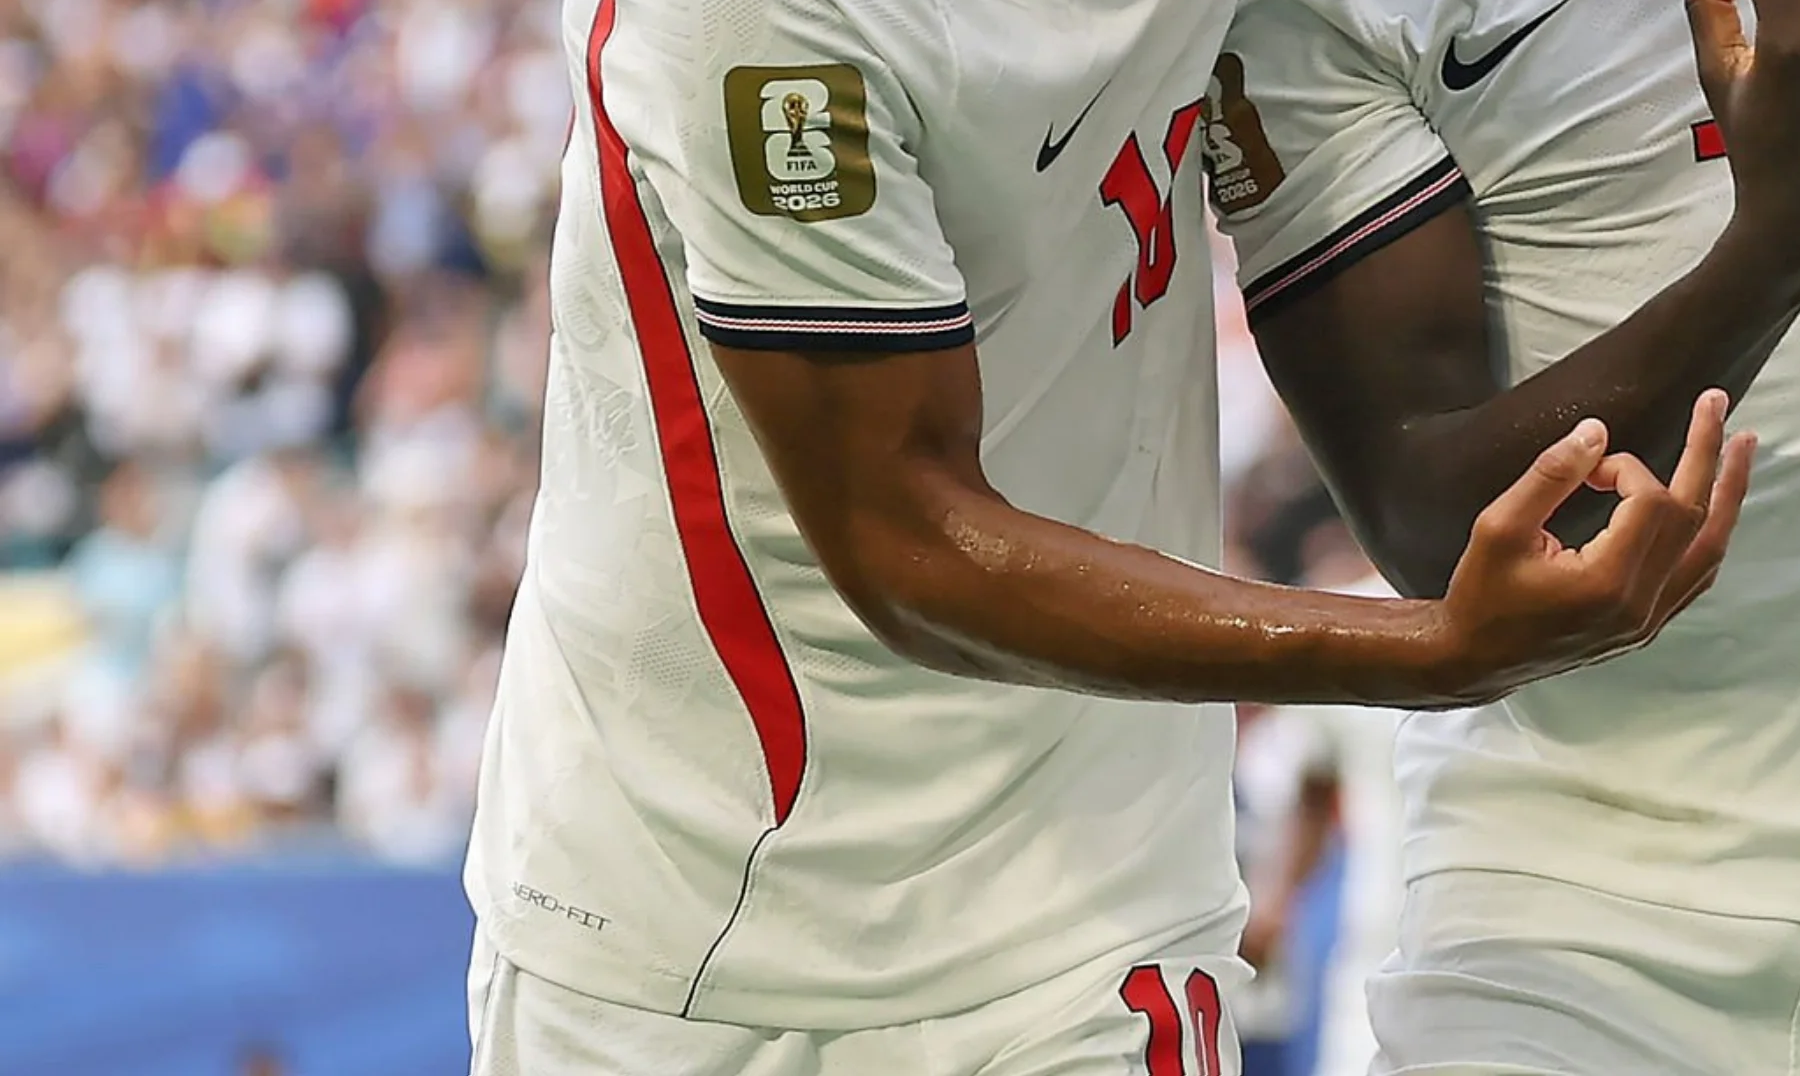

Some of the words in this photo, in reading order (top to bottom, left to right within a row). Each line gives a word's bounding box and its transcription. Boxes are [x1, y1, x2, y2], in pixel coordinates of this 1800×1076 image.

[787, 160, 817, 171] FIFA
[770, 184, 813, 195] WORLD
[814, 181, 838, 193] CUP
[1217, 179, 1258, 203] 2026
[772, 192, 840, 211] 2026
